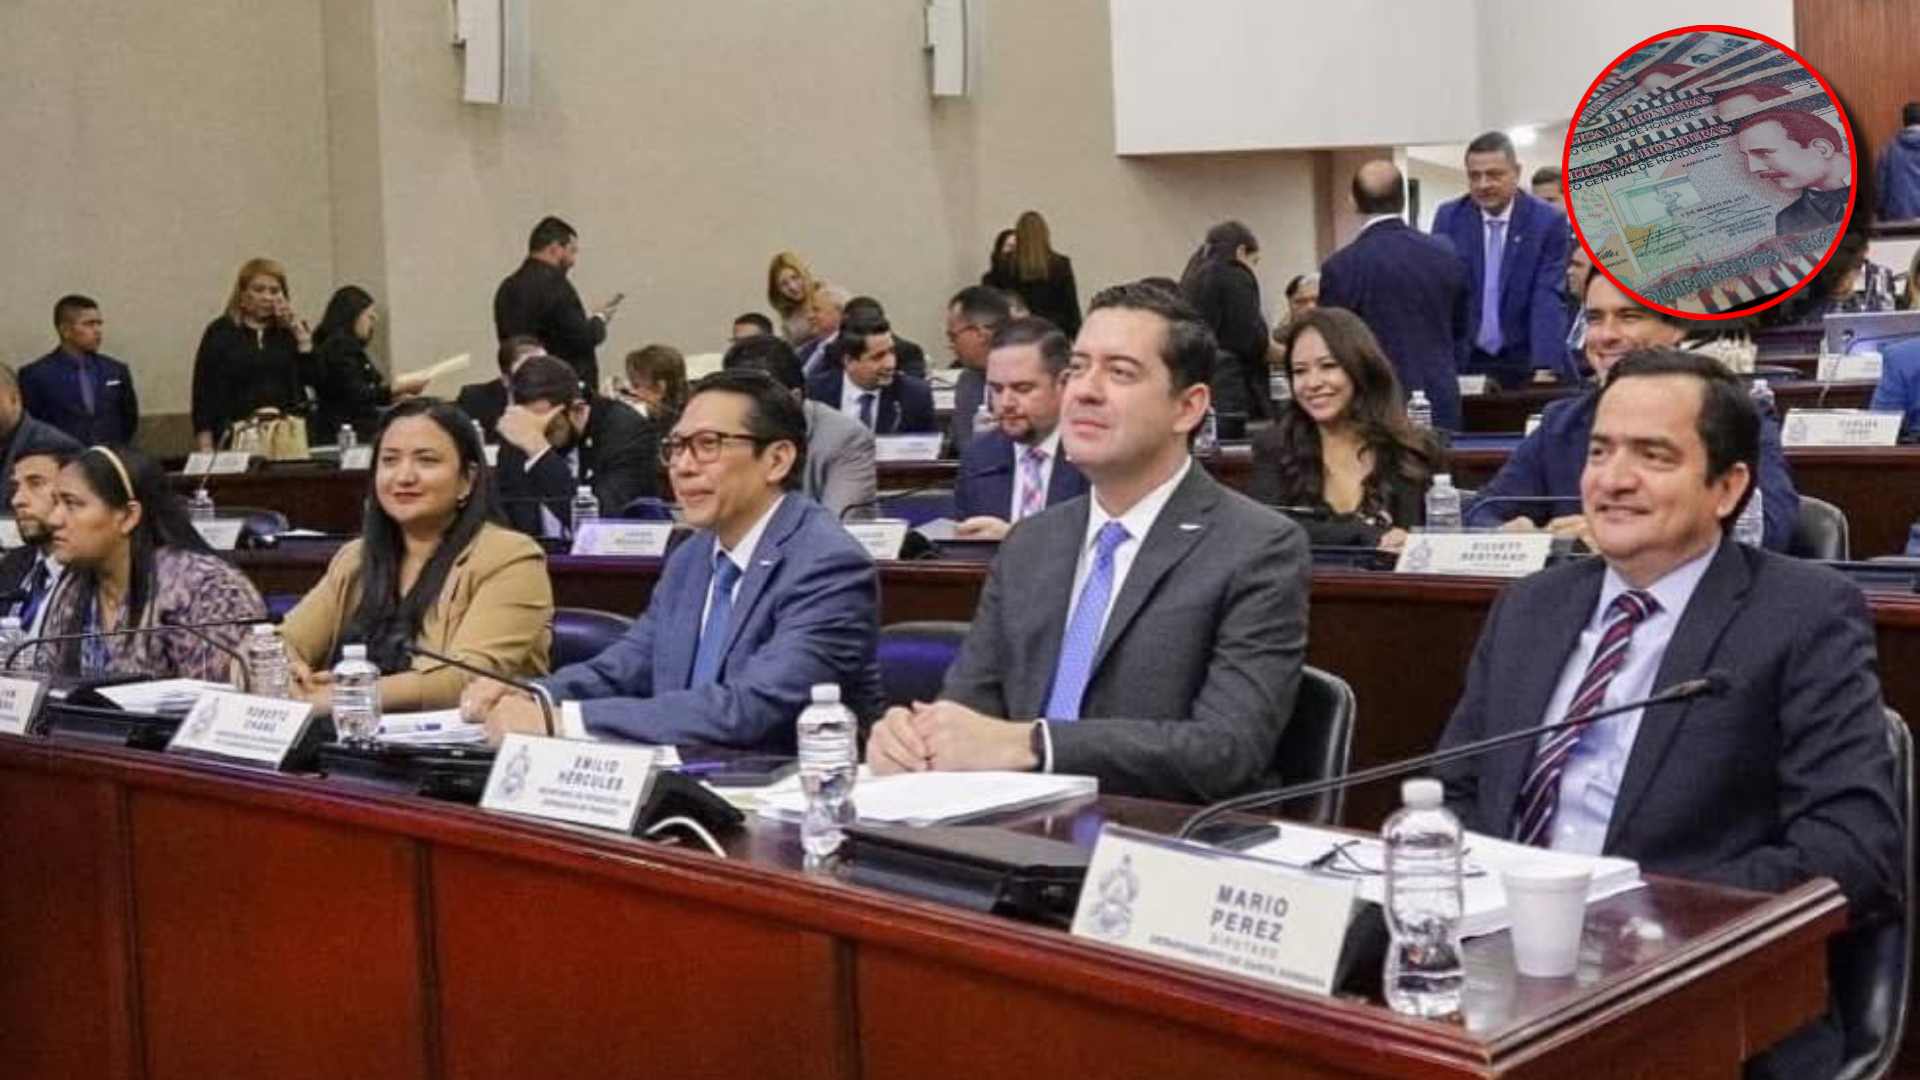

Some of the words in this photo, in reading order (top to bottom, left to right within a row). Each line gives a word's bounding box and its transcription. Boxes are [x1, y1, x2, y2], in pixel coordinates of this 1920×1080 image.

[1630, 95, 1713, 127] HONDURAS
[1581, 133, 1627, 153] CENTRAL
[1645, 109, 1702, 132] HONDURAS
[1638, 125, 1732, 159] HONDURAS
[1585, 168, 1635, 188] CENTRAL
[1639, 160, 1655, 171] DE
[1656, 141, 1720, 164] HONDURAS
[574, 756, 620, 773] EMILIO
[1217, 884, 1289, 918] MARIO
[1210, 909, 1283, 943] PEREZ
